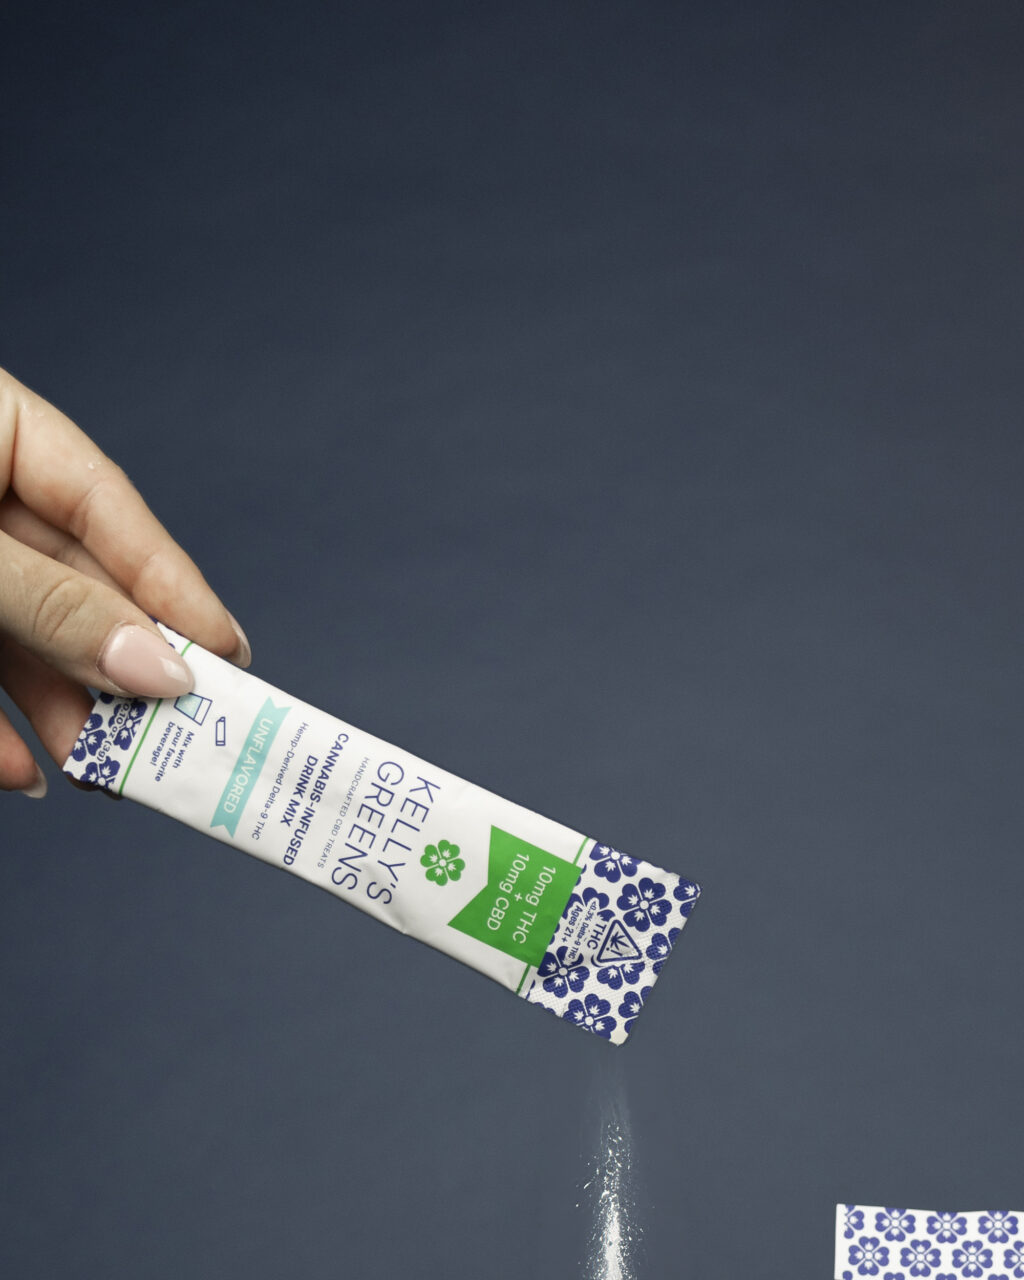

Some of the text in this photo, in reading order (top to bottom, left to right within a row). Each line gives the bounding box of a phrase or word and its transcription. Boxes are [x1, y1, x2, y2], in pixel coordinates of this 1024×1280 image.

[96, 703, 130, 762] 0.10 oz (3g)
[150, 721, 176, 766] beverage!
[155, 725, 184, 782] your favorite
[172, 731, 195, 769] Mix with
[224, 718, 273, 814] UNFLAVORED
[252, 722, 309, 841] Hemp-Derived Delta-9 THC
[280, 754, 319, 827] DRINK MIX
[283, 733, 349, 866] CANNABIS-INFUSED
[317, 756, 370, 869] HANDCRAFTED CBD TREATS
[331, 761, 405, 890] GREENS
[366, 776, 441, 905] KELLY'S
[486, 853, 531, 931] 10mg CBD
[512, 866, 556, 945] 10mg THC
[561, 905, 583, 943] Ages 21+
[568, 901, 597, 960] <0.3% Delta-9 THC
[587, 924, 607, 950] THC
